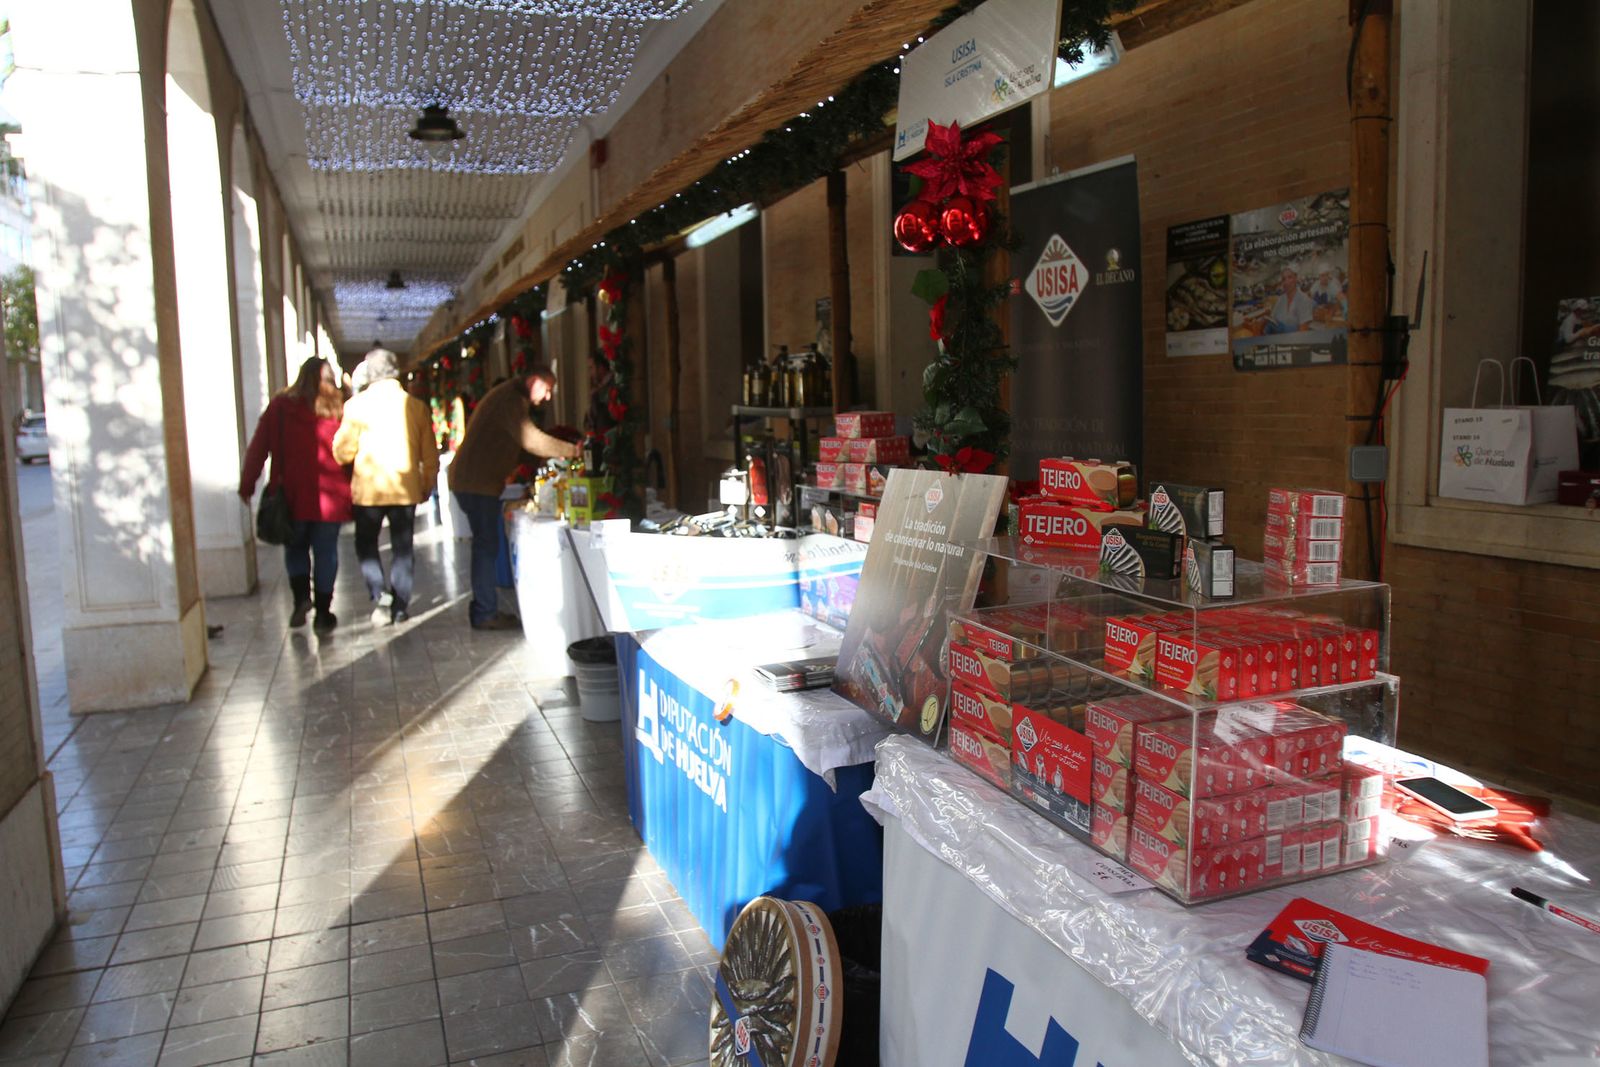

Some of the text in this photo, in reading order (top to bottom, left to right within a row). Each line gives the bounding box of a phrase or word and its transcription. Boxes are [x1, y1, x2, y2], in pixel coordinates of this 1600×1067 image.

[951, 38, 977, 64] USISA
[1244, 225, 1337, 250] La elaboración artesanal
[1263, 241, 1314, 257] nos distingue
[1036, 263, 1079, 298] USISA
[1105, 269, 1135, 284] DECANO
[1485, 458, 1515, 468] Huelva
[1041, 468, 1081, 490] TEJERO
[904, 517, 946, 536] La tradición
[1025, 514, 1088, 537] TEJERO
[885, 529, 894, 543] de
[894, 533, 926, 549] conservar
[926, 537, 935, 550] lo
[1105, 535, 1123, 546] USISA
[988, 638, 1010, 655] TEJERO
[1106, 622, 1139, 646] TEJERO
[950, 650, 982, 677] TEJERO
[1158, 639, 1198, 665] TEJERO
[952, 690, 985, 719] TEJERO
[659, 688, 732, 777] DIPUTACIÓN
[1086, 707, 1119, 734] TEJERO
[951, 727, 983, 759] TEJERO
[1137, 731, 1177, 760] TEJERO
[661, 724, 728, 814] DE HUELVA
[1094, 758, 1113, 779] ERO
[1137, 779, 1174, 810] TEJERO
[1132, 827, 1169, 858] TEJERO
[1302, 921, 1340, 942] USISA
